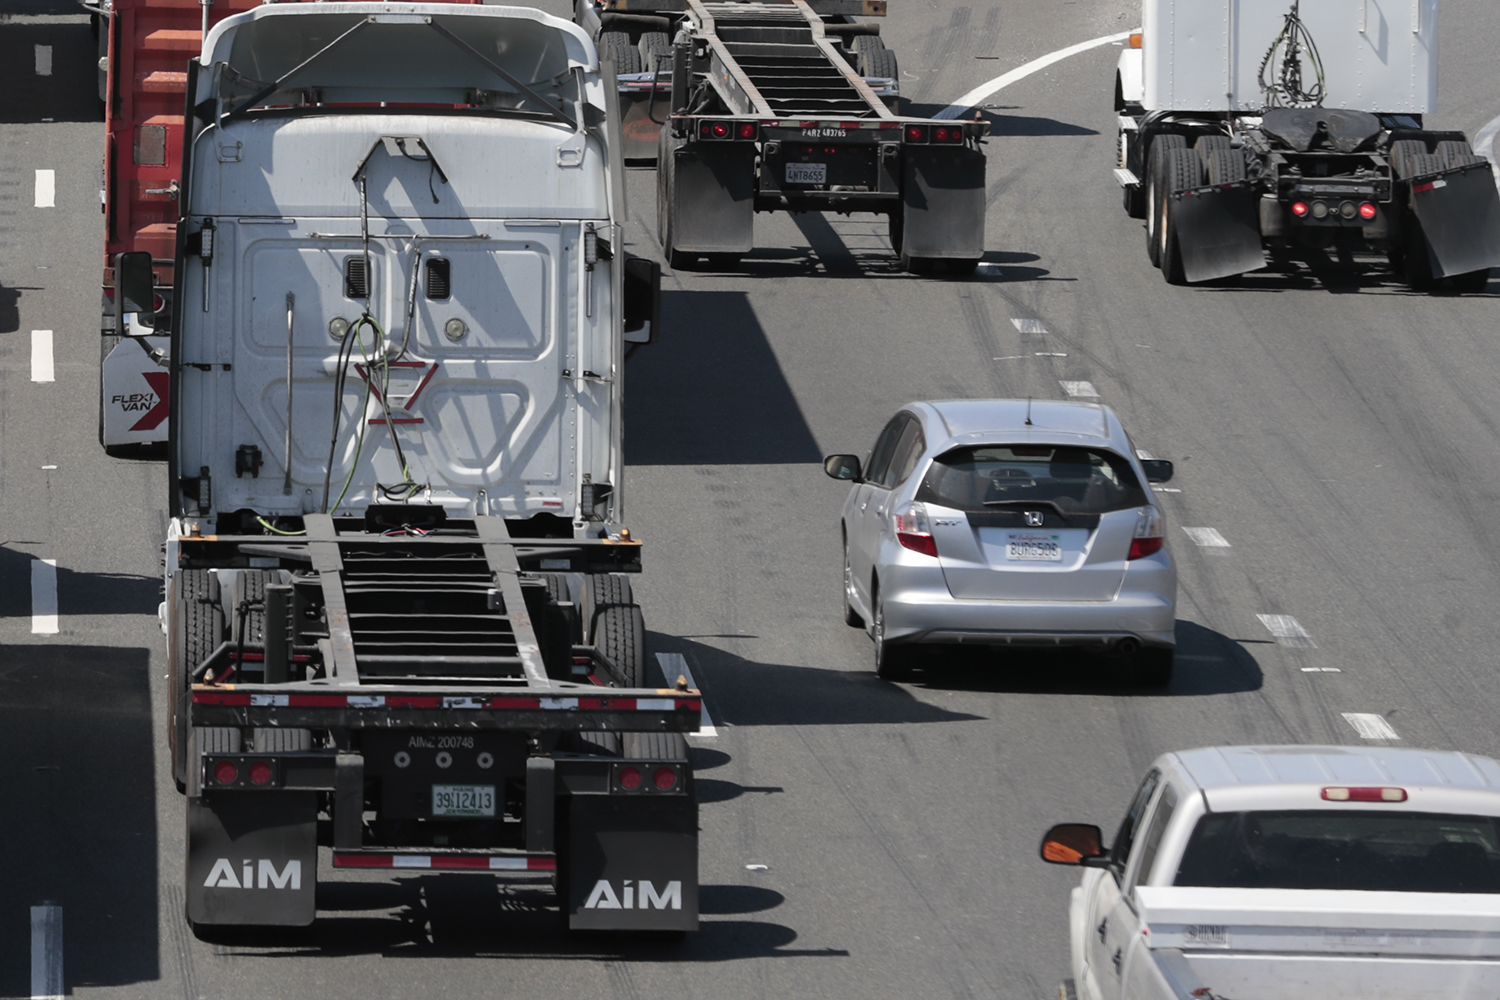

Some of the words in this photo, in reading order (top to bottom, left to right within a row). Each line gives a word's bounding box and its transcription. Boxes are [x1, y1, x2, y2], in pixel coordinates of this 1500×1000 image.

[788, 171, 823, 180] 4NT8655
[121, 402, 152, 412] VAN
[438, 736, 474, 749] 200748
